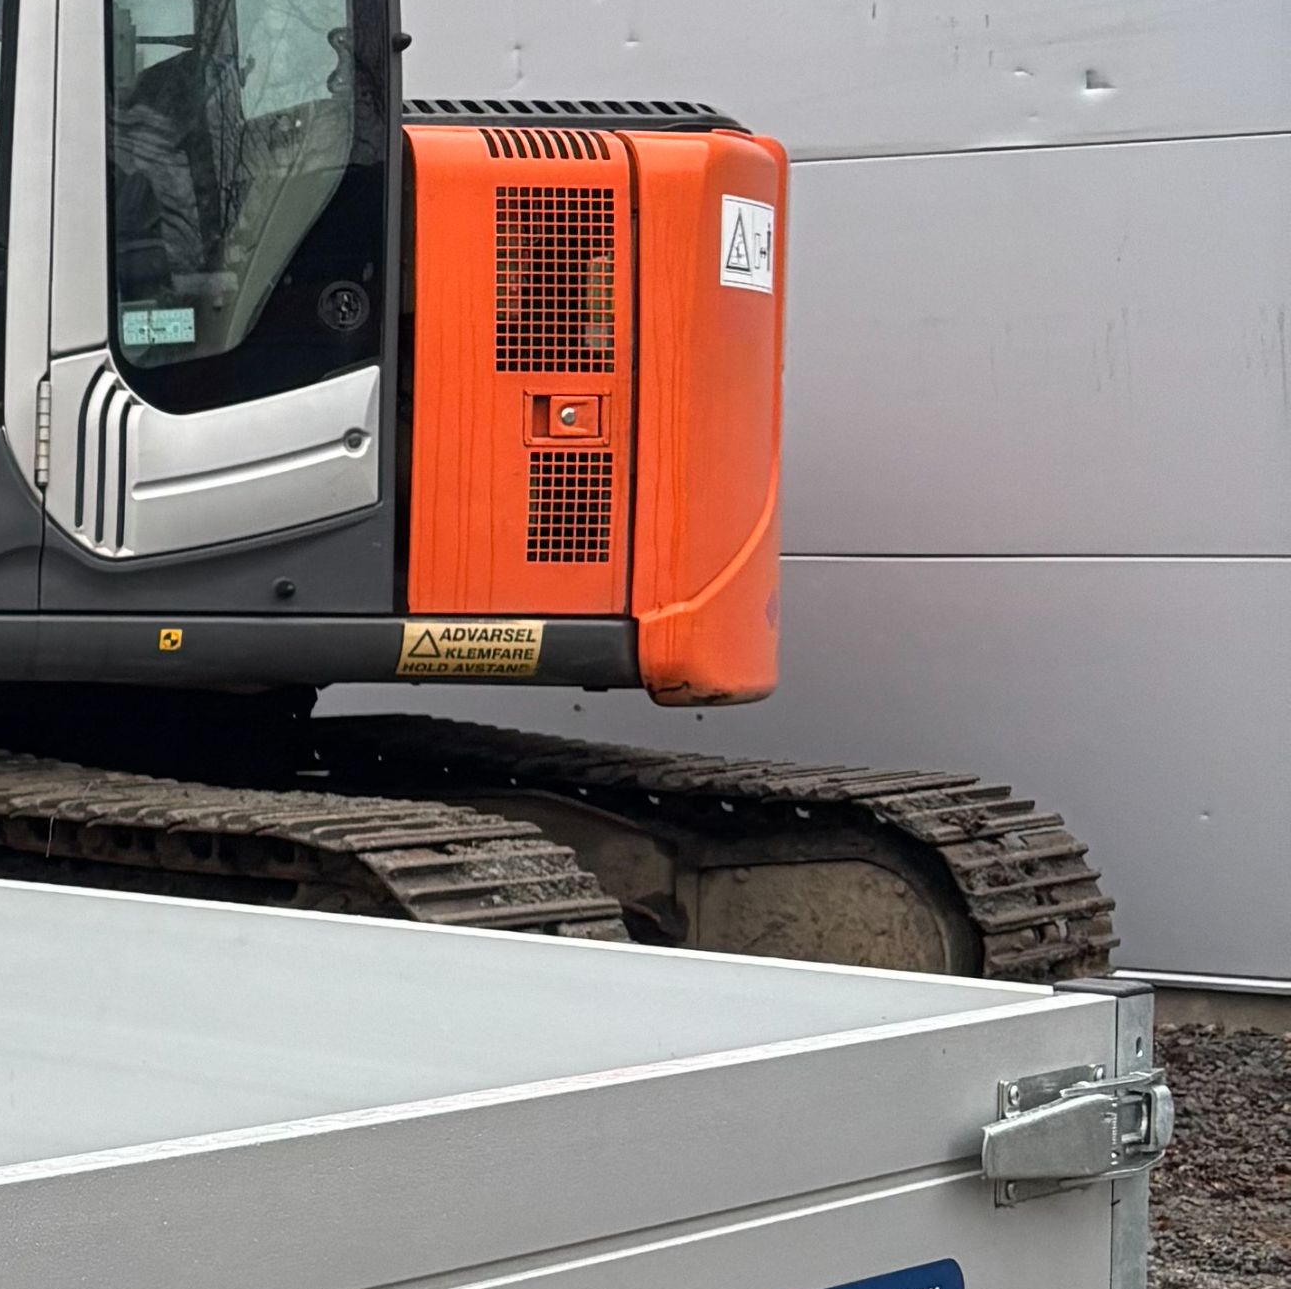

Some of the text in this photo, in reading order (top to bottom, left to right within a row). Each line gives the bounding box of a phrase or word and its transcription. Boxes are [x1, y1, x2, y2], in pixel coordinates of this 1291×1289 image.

[439, 627, 537, 643] ADVARSEL
[445, 647, 535, 660] KLEMFARE
[402, 662, 529, 674] HOLD AVSTAND
